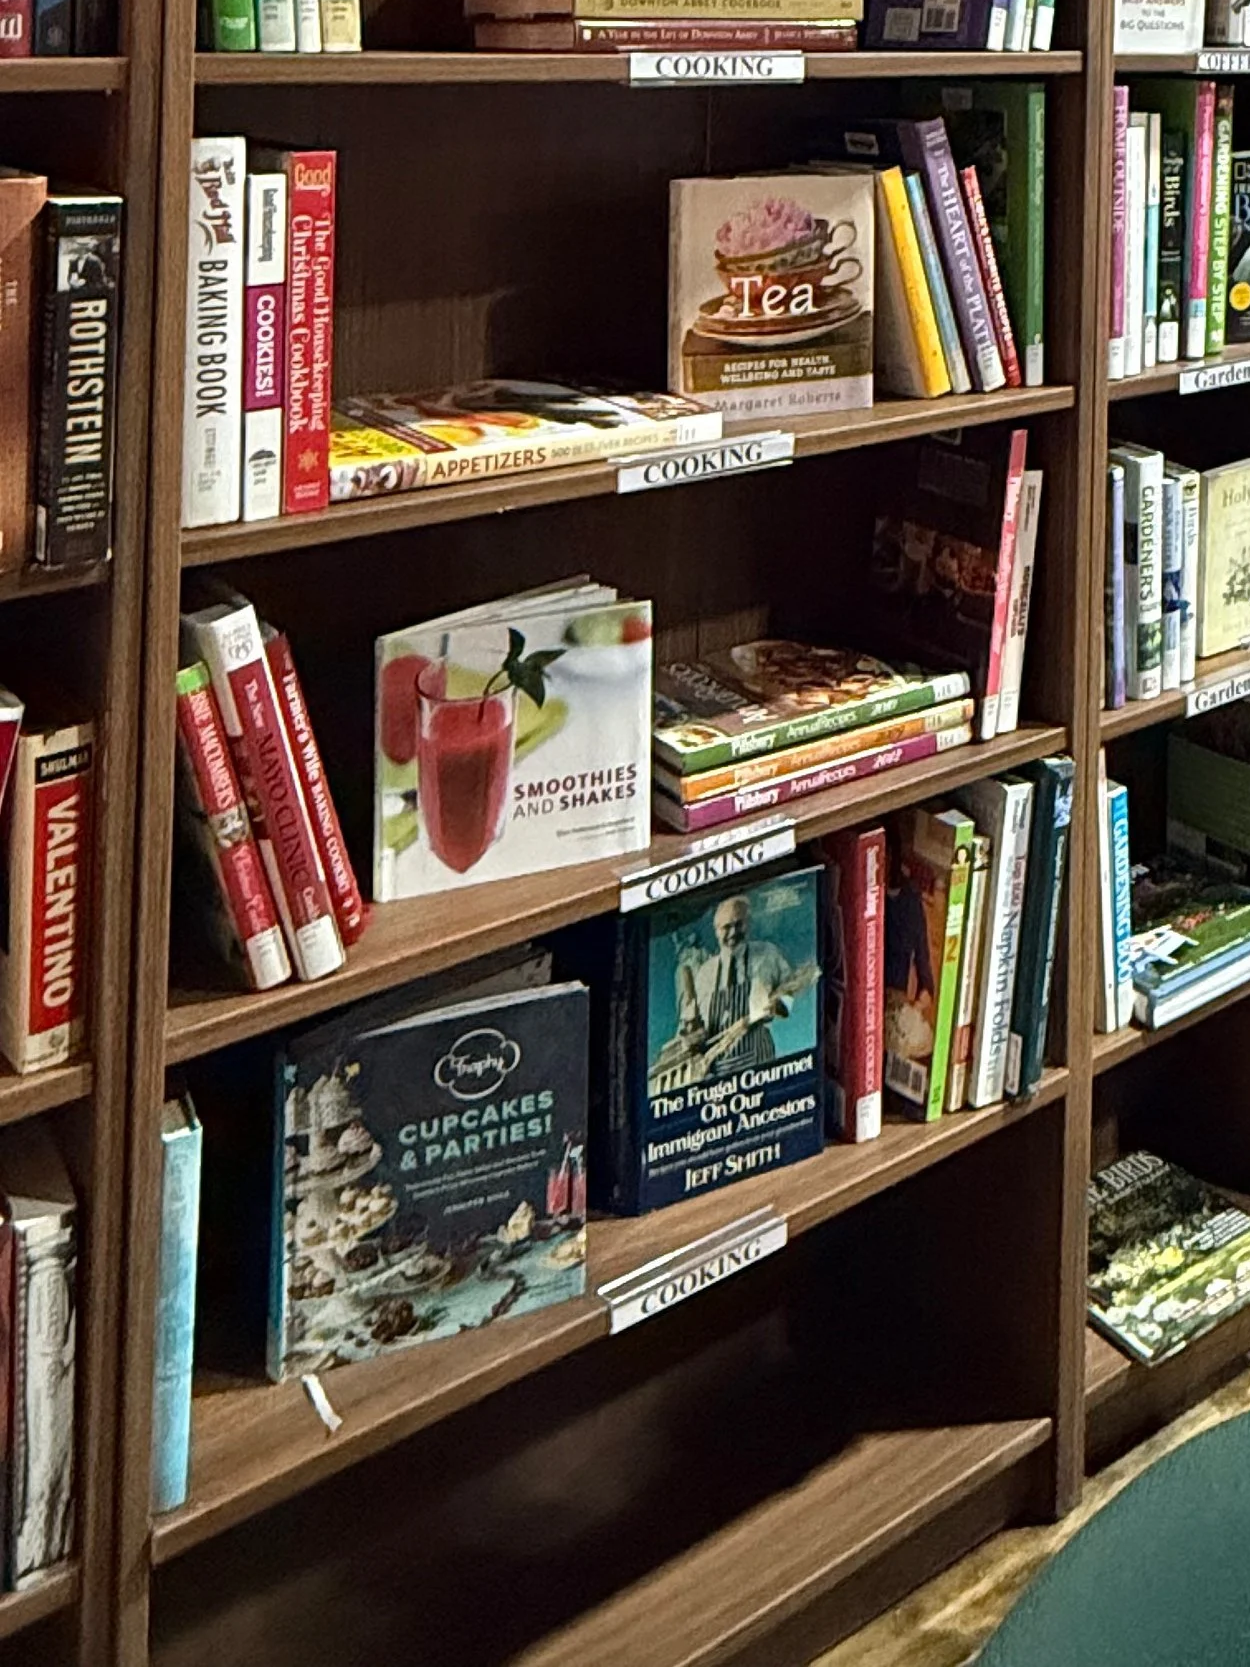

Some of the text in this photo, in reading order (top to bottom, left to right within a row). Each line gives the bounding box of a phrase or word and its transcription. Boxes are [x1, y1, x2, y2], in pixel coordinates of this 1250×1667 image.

[1119, 18, 1185, 32] BIG QUESTIONS
[656, 55, 774, 78] COOKING
[1112, 105, 1128, 234] HOME OUTSIDE
[940, 188, 971, 261] HEART
[1163, 175, 1182, 228] Birds
[1211, 119, 1231, 323] GARDENING STEP BY STEP
[288, 213, 312, 435] Christmas Cookbook
[308, 213, 333, 432] The Good Housekeeping
[728, 275, 820, 319] Tea
[195, 259, 229, 421] BAKING BOOK
[255, 293, 276, 399] COOKIES!
[723, 358, 766, 373] RECIPES
[768, 357, 789, 370] FOR
[65, 297, 108, 466] ROTHSTEIN
[713, 389, 842, 415] Margaret Roberts
[719, 364, 836, 386] WELLBEING AND TASTE
[431, 446, 548, 481] APPETIZERS
[642, 441, 763, 486] COOKING
[1138, 484, 1156, 602] GARDENERS
[281, 668, 335, 836] Farmer's Wife BAKING
[731, 731, 777, 758] Pillsbury
[244, 678, 311, 884] The New MAYO CLINIC
[512, 782, 637, 822] AND SHAKES
[513, 762, 638, 802] SMOOTHIES
[734, 787, 782, 813] Pillsbury
[41, 793, 82, 1008] VALENTINO
[644, 842, 764, 904] COOKING
[1112, 818, 1131, 937] GARDENING
[989, 908, 1019, 1046] Napkin Folds
[649, 1054, 815, 1120] The Frugal Gourmet
[700, 1088, 765, 1125] On Our
[397, 1090, 556, 1147] CUPCAKES
[401, 1113, 554, 1171] & PARTIES!
[647, 1119, 734, 1166] Immigrant
[736, 1093, 817, 1132] Ancestors
[683, 1163, 724, 1193] JEFF
[724, 1141, 782, 1177] SMITH
[1096, 1149, 1165, 1191] BIRDS
[638, 1236, 763, 1318] COOKING
